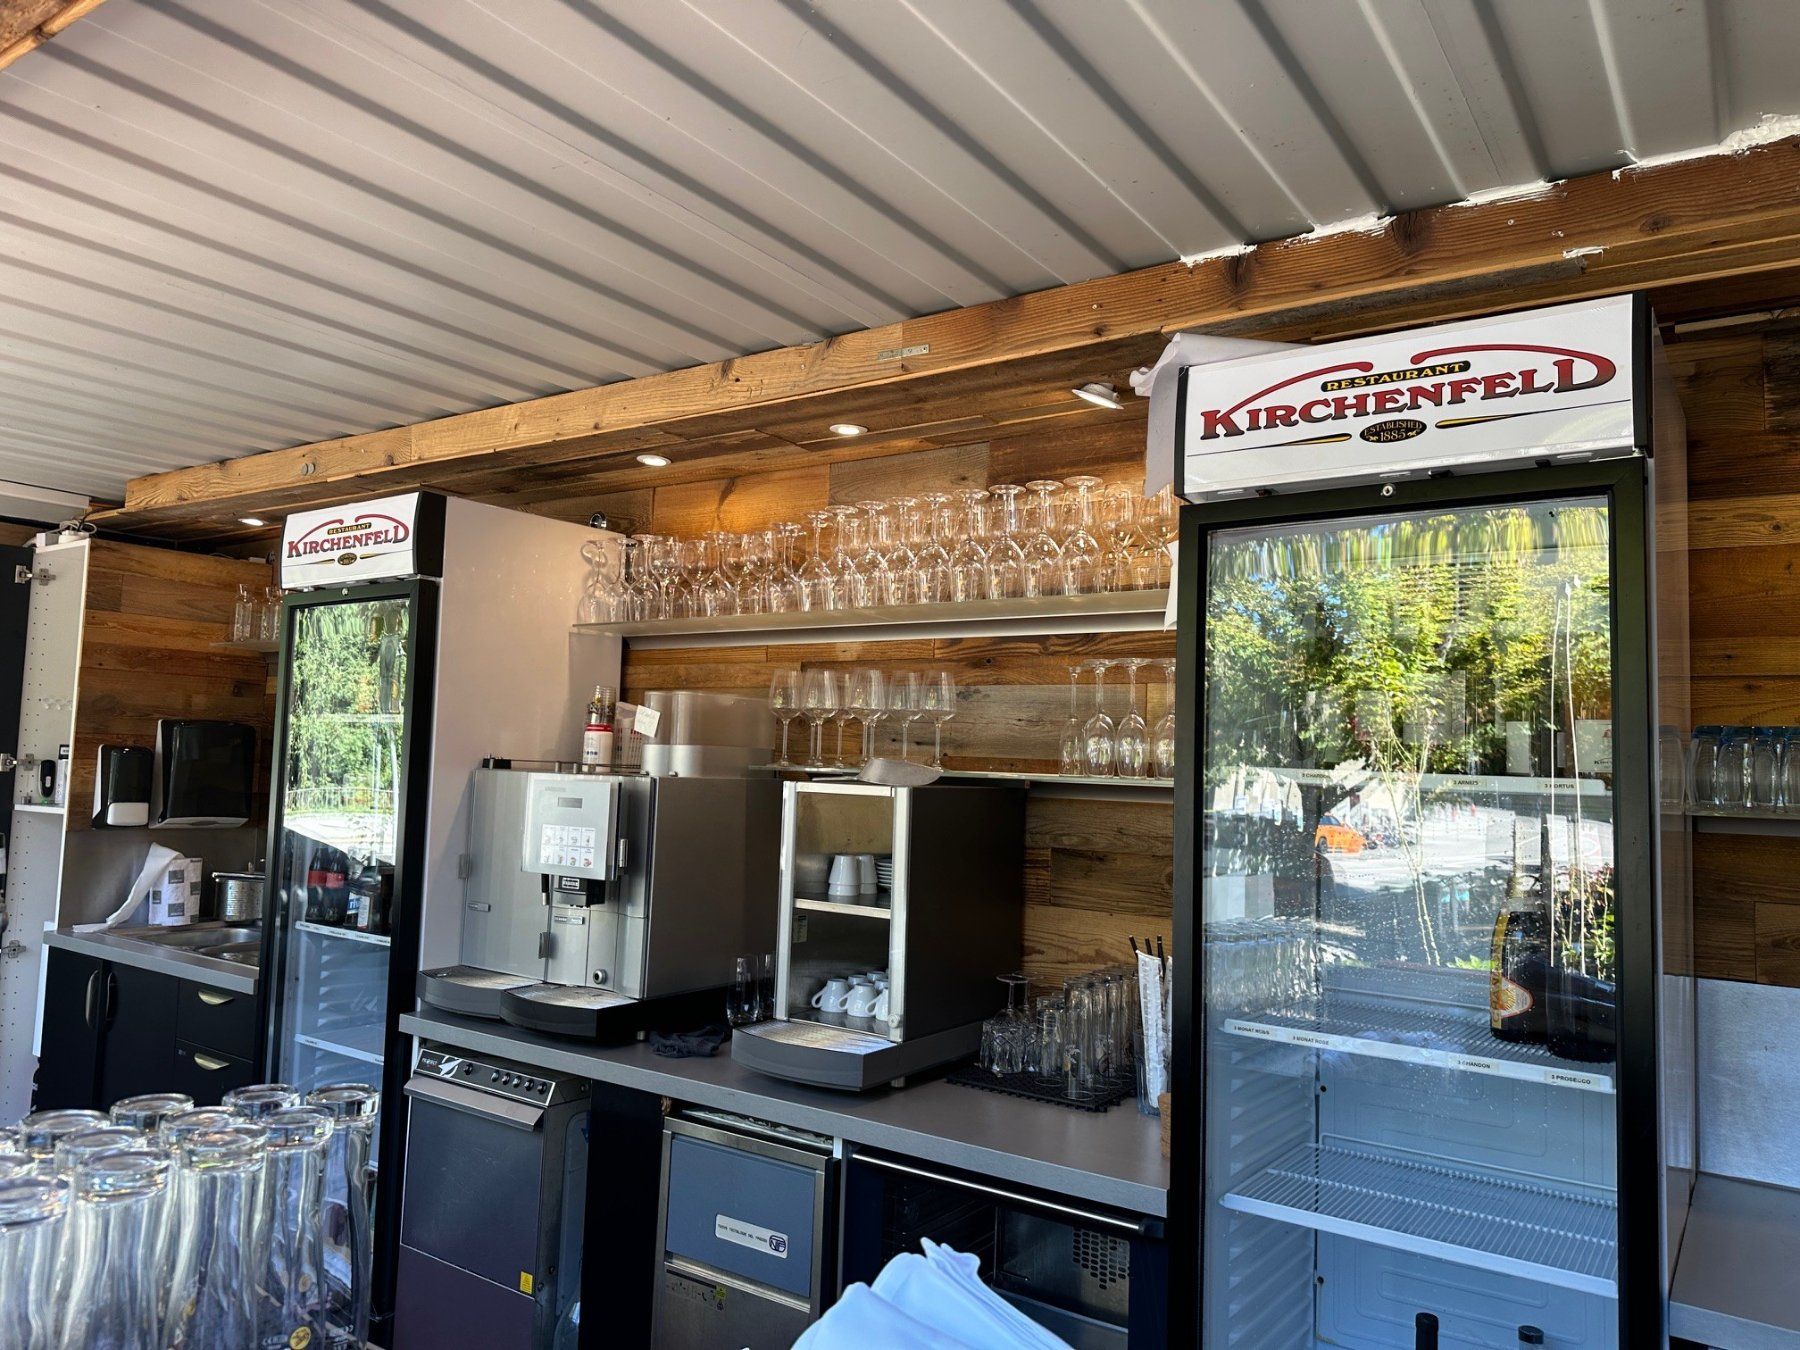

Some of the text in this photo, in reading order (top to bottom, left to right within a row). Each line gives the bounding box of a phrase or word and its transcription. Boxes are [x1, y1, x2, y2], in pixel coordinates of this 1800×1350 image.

[1326, 362, 1467, 391] RESTAURANT
[1200, 348, 1617, 441] KIRCHENFELD
[1364, 421, 1423, 436] ESTABLISHED
[1380, 428, 1406, 442] 1885
[287, 520, 409, 558] KIRCHENFELD
[328, 523, 370, 535] RESTAURANT
